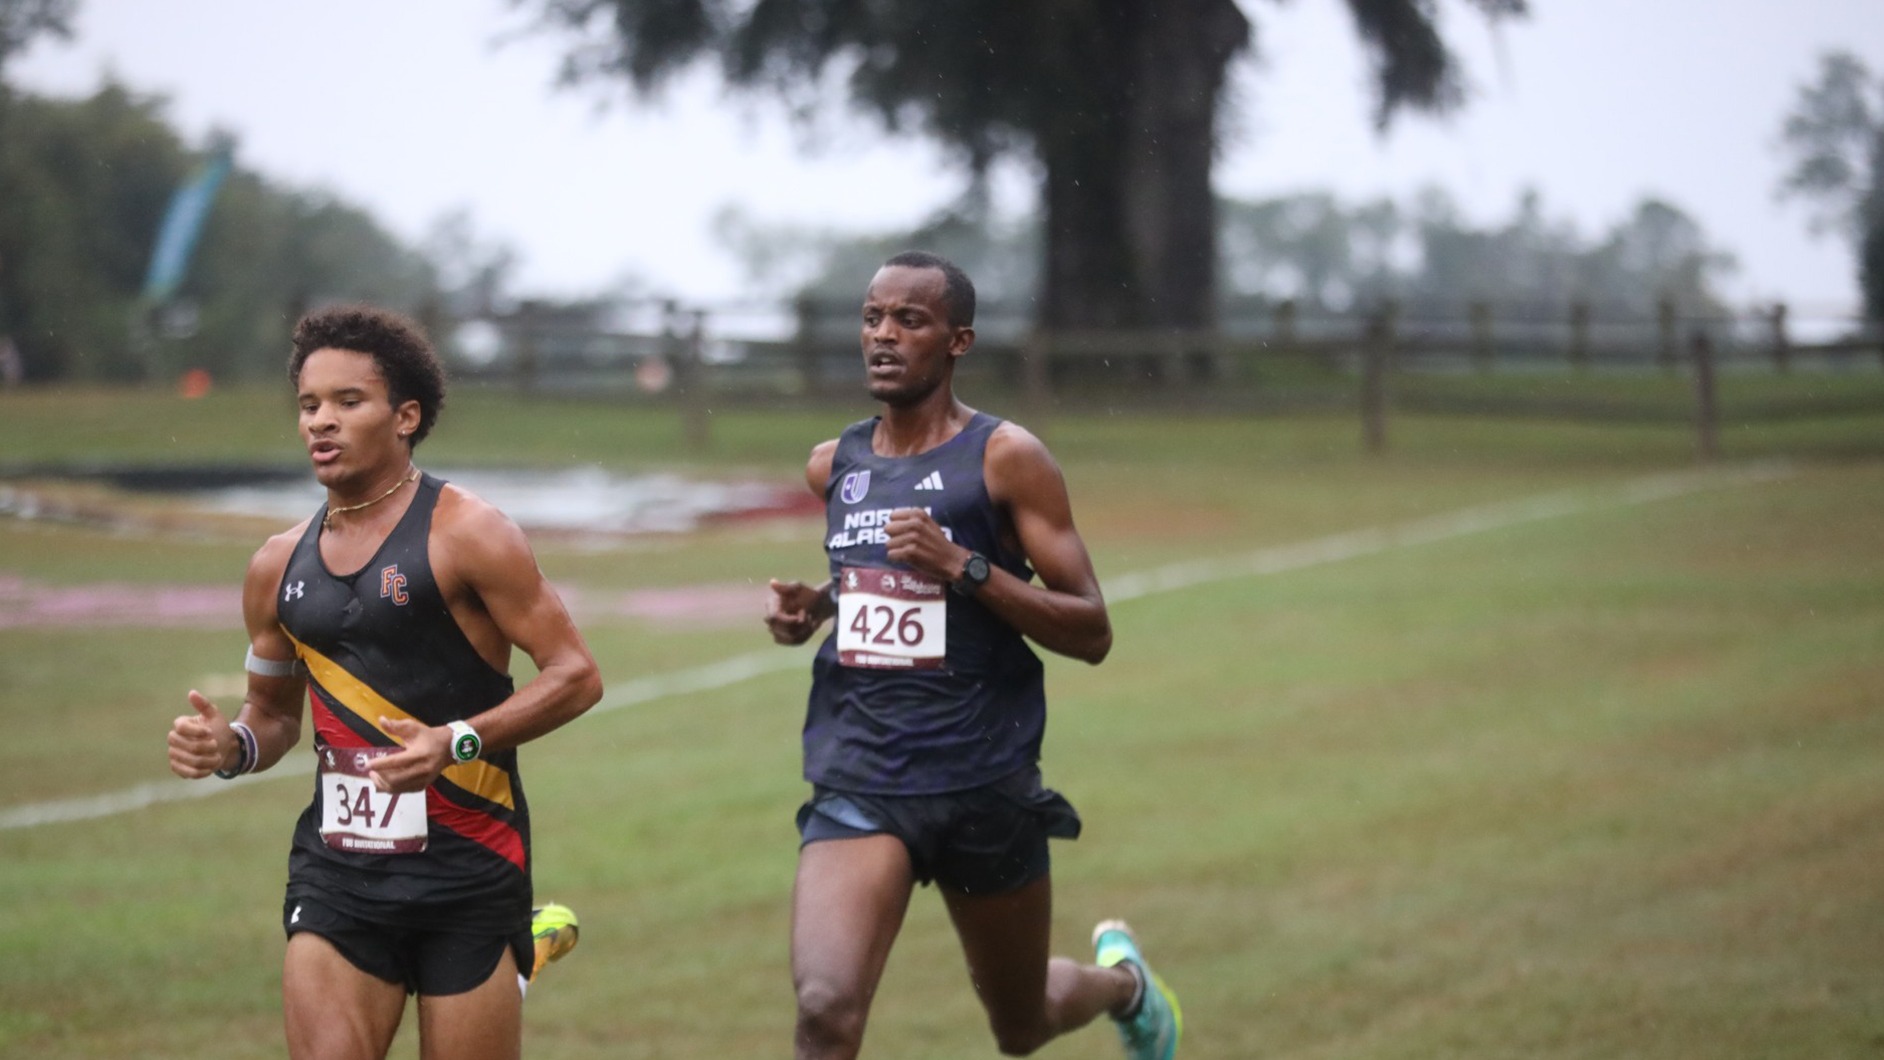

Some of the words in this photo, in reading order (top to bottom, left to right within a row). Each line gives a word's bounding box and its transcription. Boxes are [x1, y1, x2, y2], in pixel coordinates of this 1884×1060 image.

[844, 507, 931, 530] NOR
[380, 564, 410, 606] FC
[850, 604, 924, 647] 426
[336, 783, 401, 828] 347
